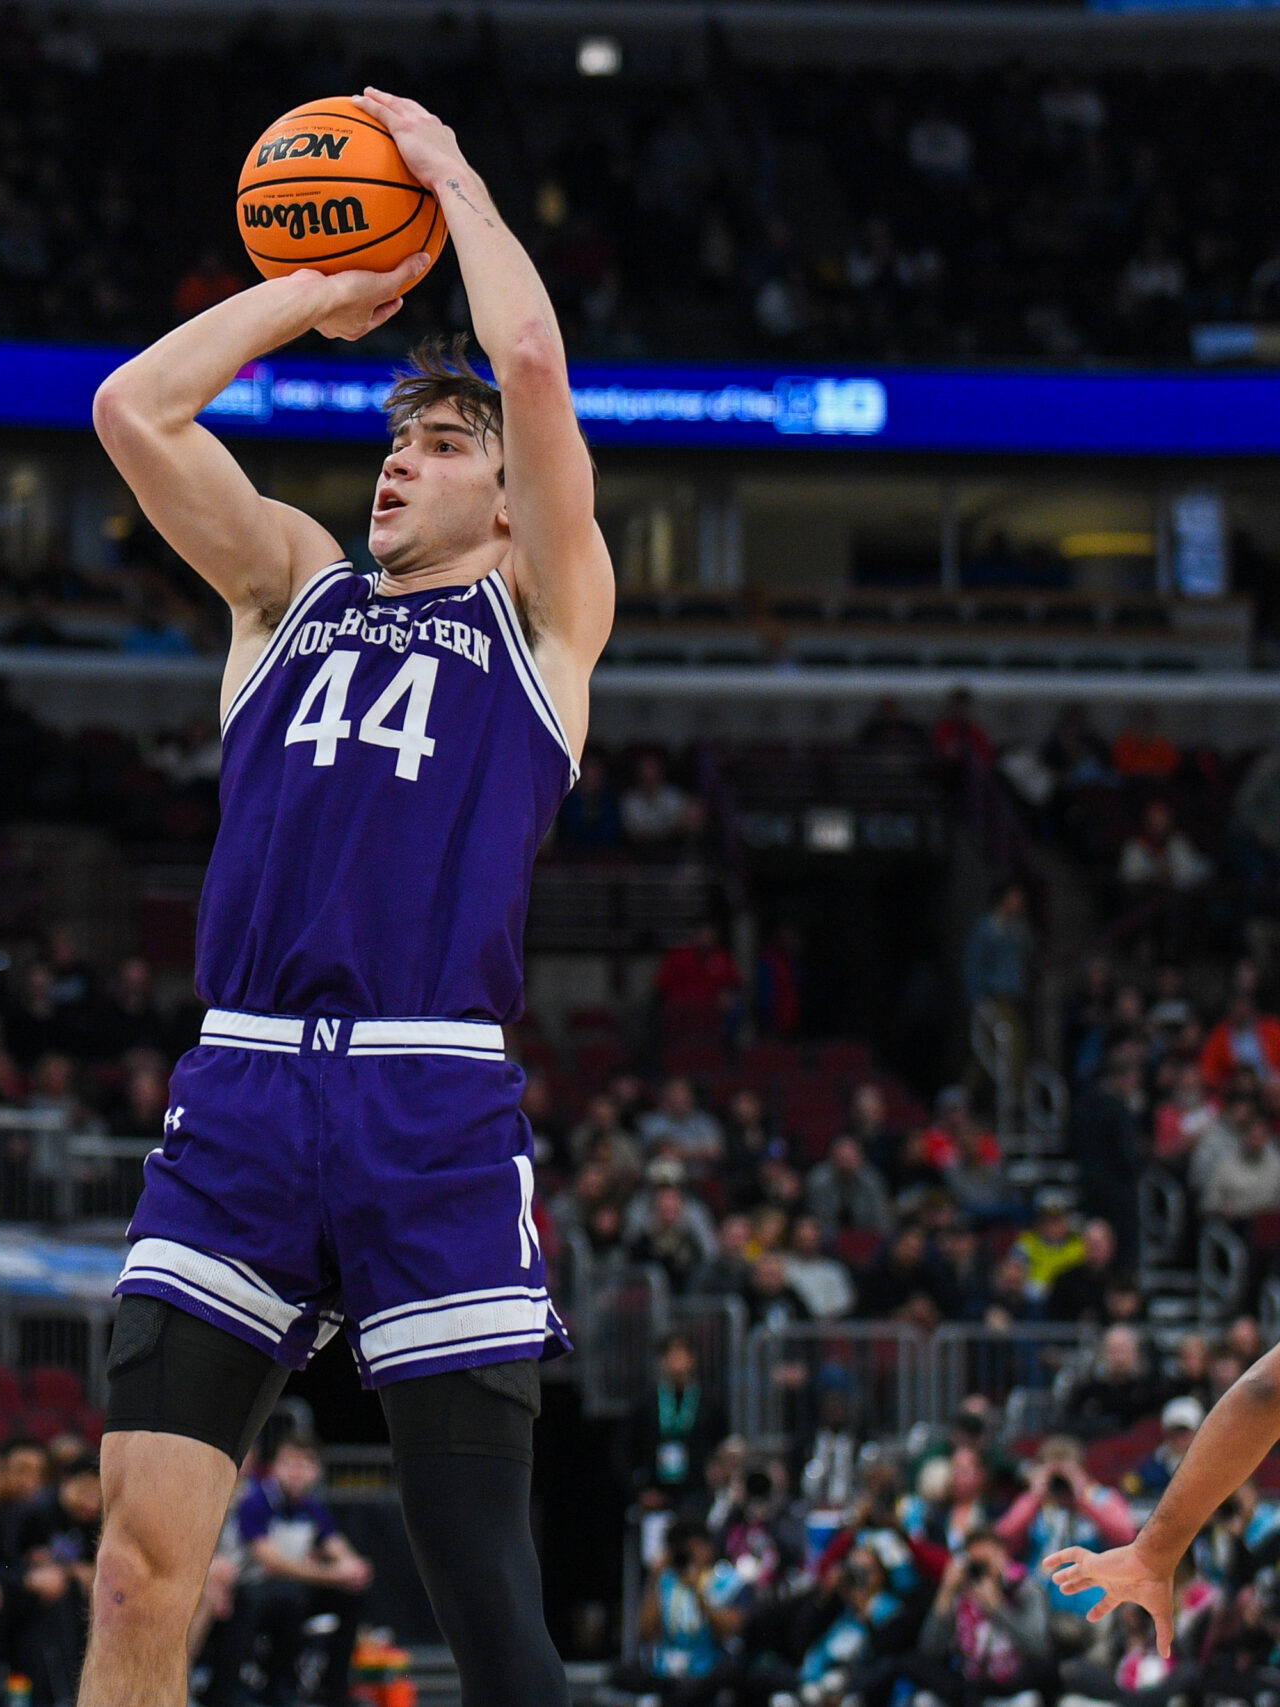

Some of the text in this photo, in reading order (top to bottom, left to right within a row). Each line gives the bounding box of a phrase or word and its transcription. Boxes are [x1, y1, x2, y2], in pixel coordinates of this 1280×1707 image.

[256, 133, 350, 169] NCAA
[243, 195, 370, 241] Wilson
[284, 649, 440, 782] 44
[311, 1017, 341, 1052] N
